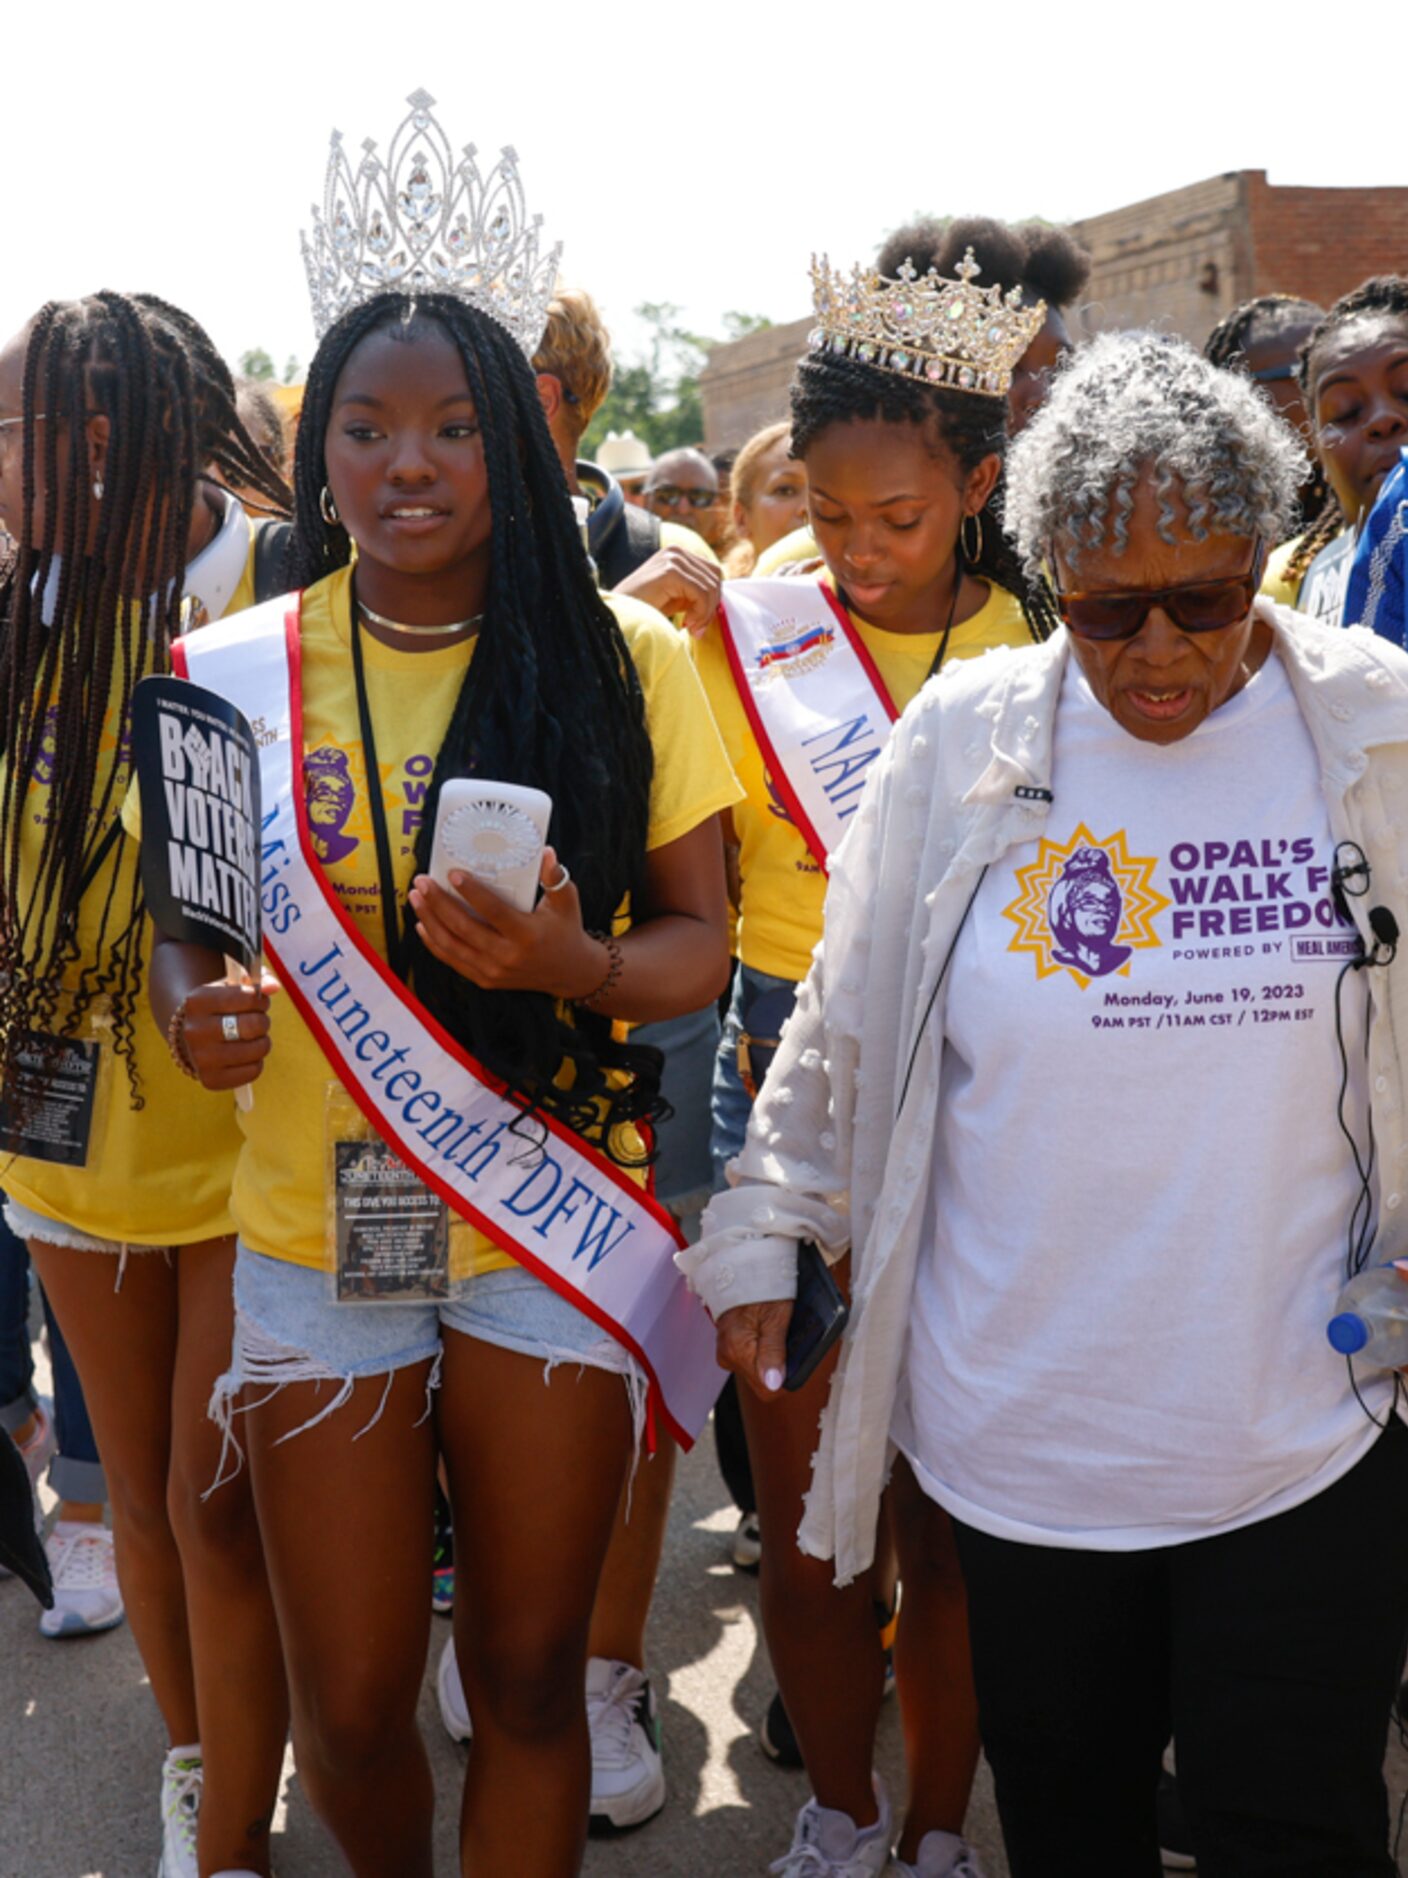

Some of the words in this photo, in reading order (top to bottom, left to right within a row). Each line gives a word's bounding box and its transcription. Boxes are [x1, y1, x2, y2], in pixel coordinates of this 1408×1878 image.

[1169, 838, 1316, 872] OPAL'S
[168, 840, 259, 952] MATTE
[1169, 872, 1294, 906] WALK
[1172, 898, 1345, 939] FREEDO
[1173, 944, 1255, 960] POWERED
[1262, 941, 1283, 955] BY
[1104, 991, 1178, 1009] Monday,
[1184, 990, 1224, 1005] June
[1231, 987, 1256, 1003] 19,
[1261, 984, 1305, 1000] 2023
[1091, 1015, 1125, 1029] 9AM
[1128, 1016, 1152, 1028] PST
[1209, 1013, 1232, 1026] CST
[1252, 1009, 1291, 1023] 12PM
[1295, 1008, 1316, 1021] EST
[299, 941, 509, 1183] Juneteenth
[500, 1157, 636, 1275] DFW
